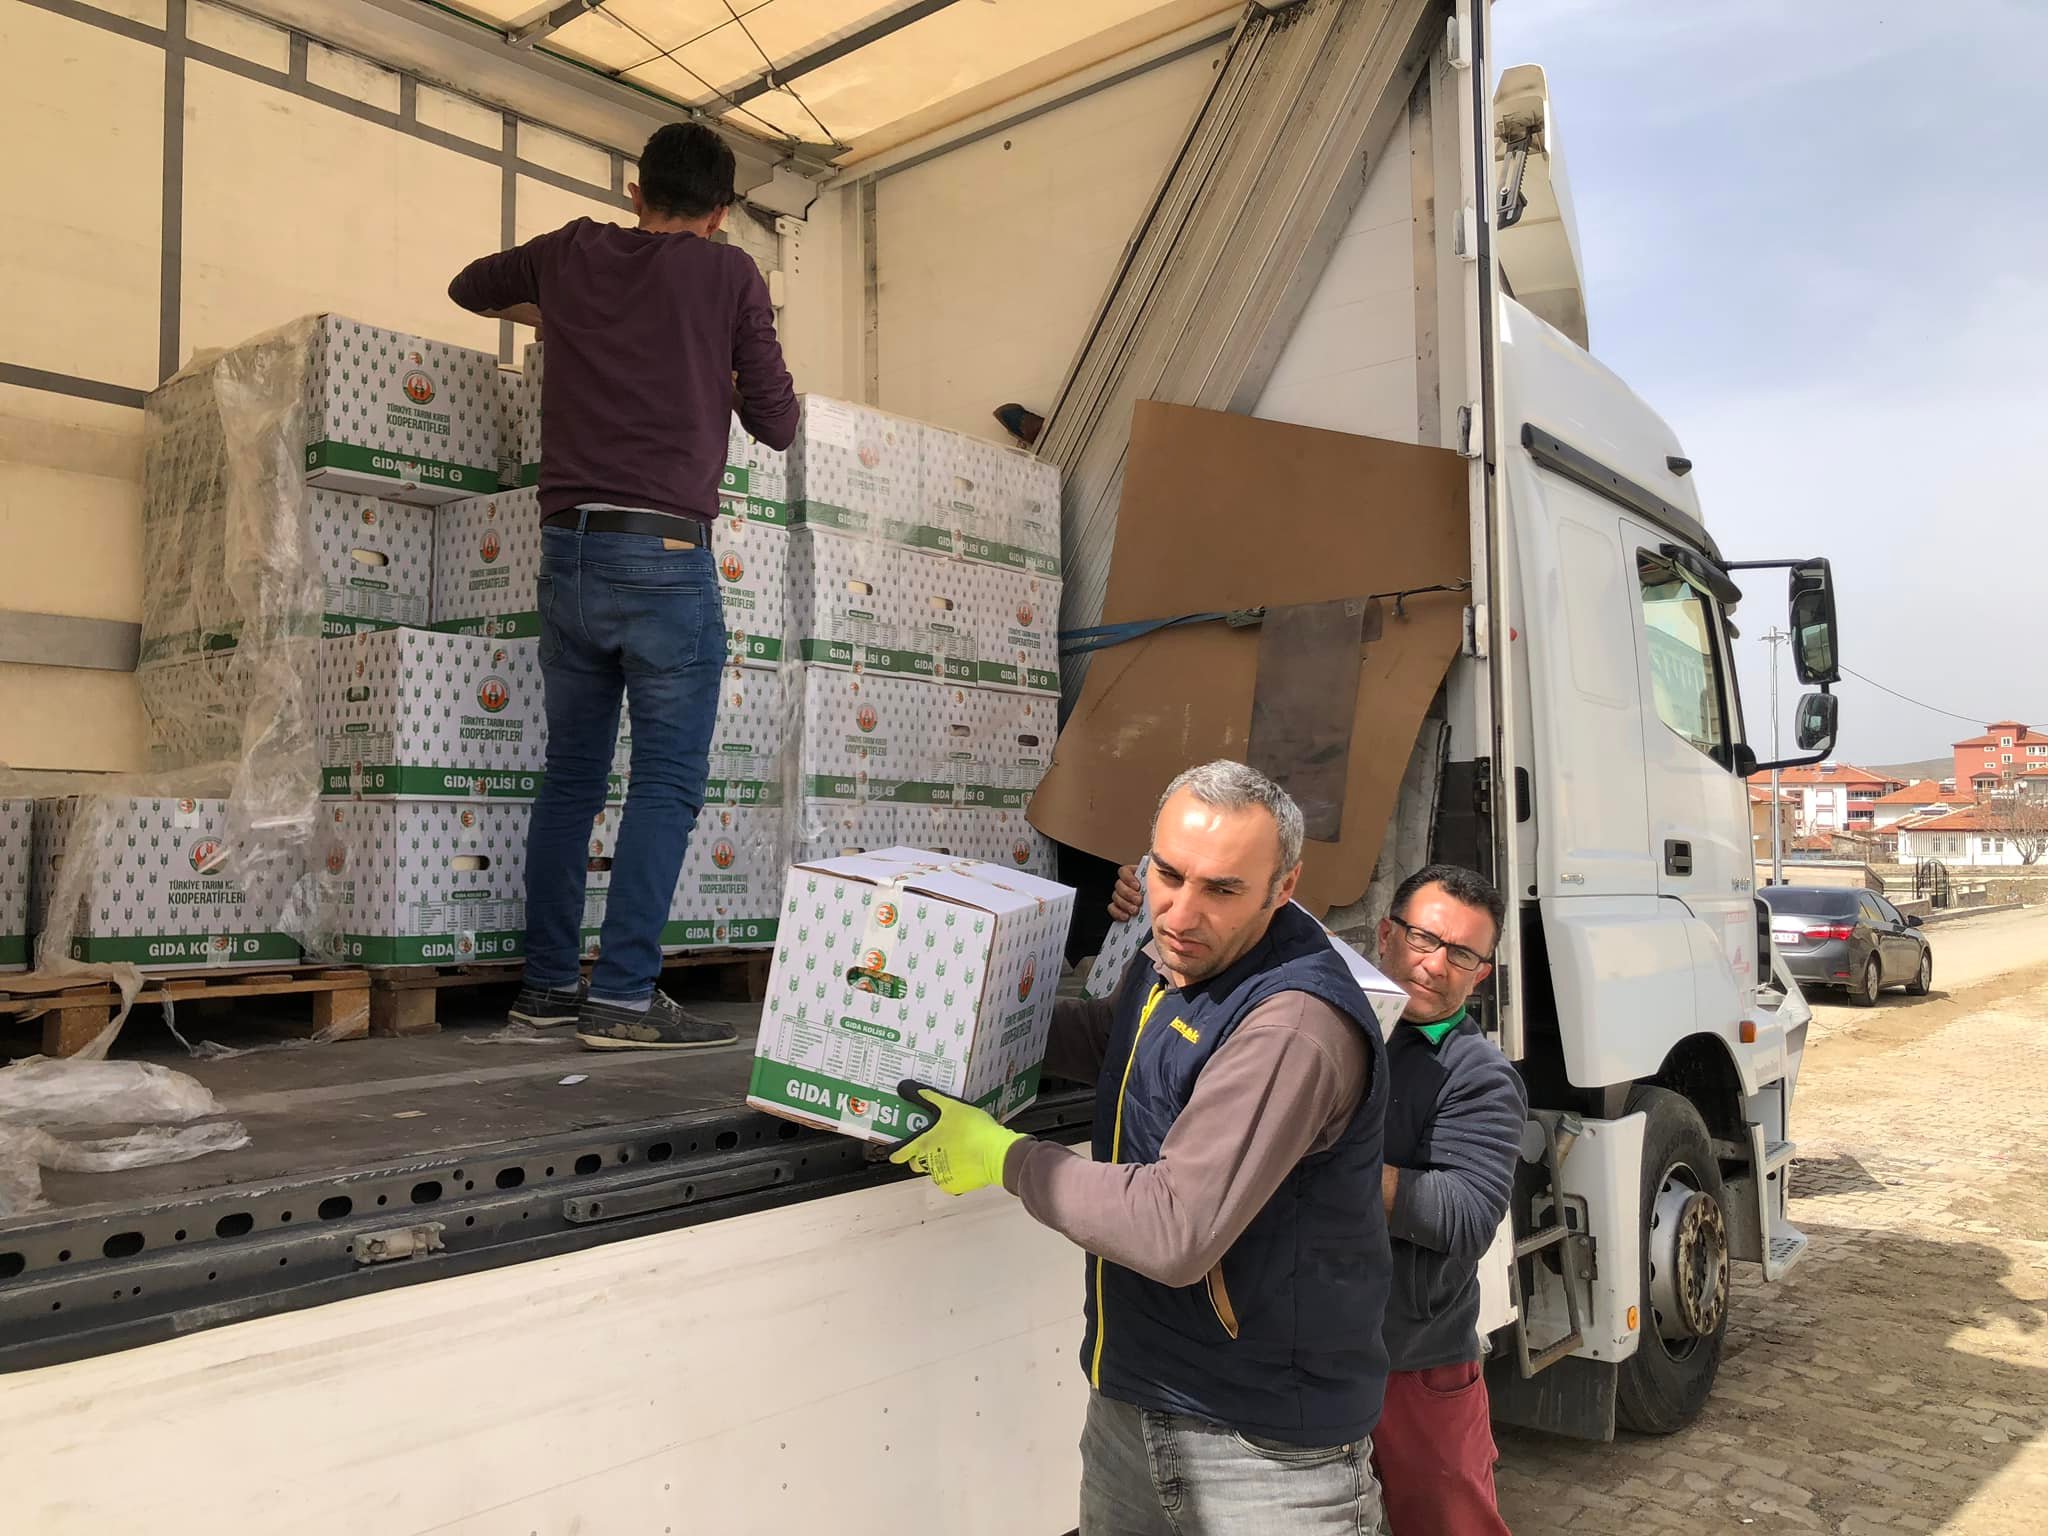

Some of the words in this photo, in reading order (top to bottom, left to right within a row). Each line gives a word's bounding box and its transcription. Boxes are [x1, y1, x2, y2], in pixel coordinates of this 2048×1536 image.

[386, 414, 450, 436] KOOPERATİFLERİ
[372, 456, 401, 471] GIDA
[322, 621, 351, 634] GIDA
[829, 648, 850, 660] GIDA
[914, 659, 933, 670] GIDA
[459, 727, 523, 742] KOOPERATİFLERİ
[330, 776, 347, 788] GIDA
[444, 775, 473, 788] GIDA
[476, 774, 516, 789] OLİSİ
[836, 784, 855, 794] GIDA
[932, 789, 950, 800] GIDA
[1003, 794, 1020, 804] GIDA
[169, 879, 200, 890] TÜRKİYE
[202, 880, 223, 890] TARIM
[168, 890, 246, 905] KOOPERATİFLERİ
[686, 927, 710, 939] GIDA
[149, 942, 186, 956] GIDA
[422, 943, 454, 957] GIDA
[845, 1021, 862, 1031] GIDA
[863, 1025, 886, 1037] KOLİSİ
[786, 1079, 831, 1108] GIDA
[836, 1093, 900, 1126] KİSİ
